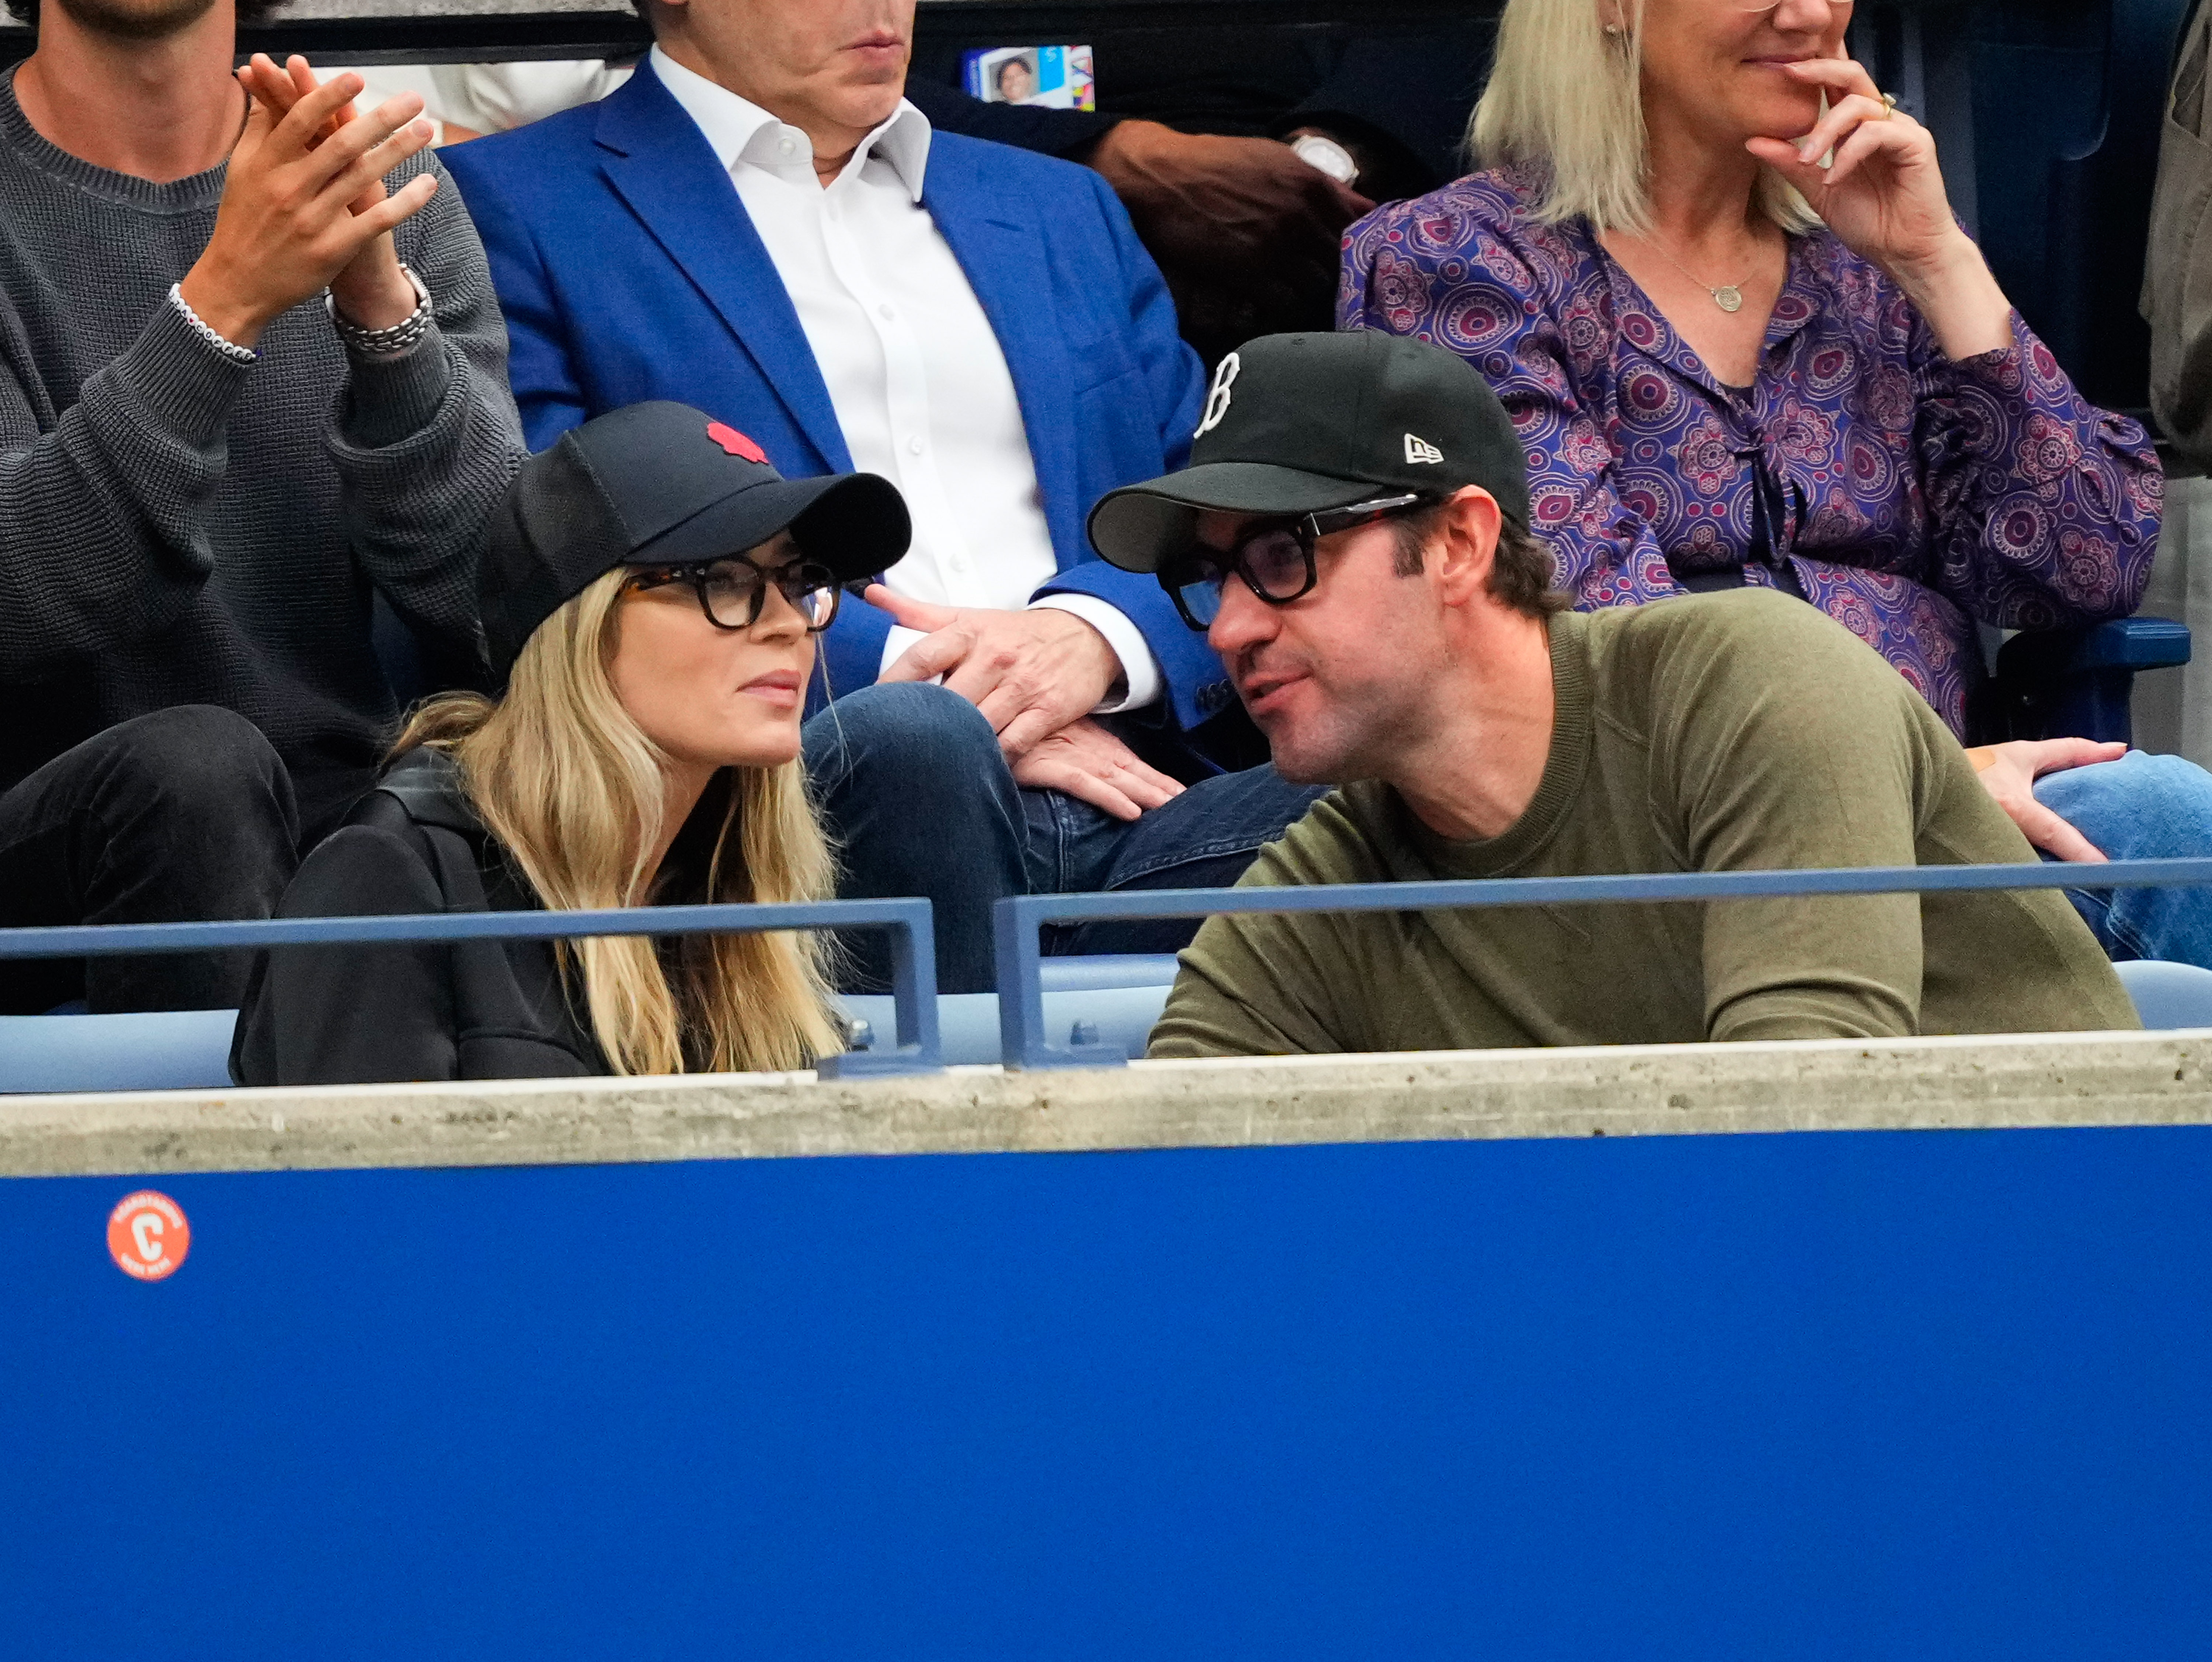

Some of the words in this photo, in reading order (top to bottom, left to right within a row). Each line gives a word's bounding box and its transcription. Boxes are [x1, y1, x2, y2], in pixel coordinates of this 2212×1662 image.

[196, 323, 252, 360] COFFEE
[1193, 352, 1240, 438] B
[132, 1213, 163, 1260] C
